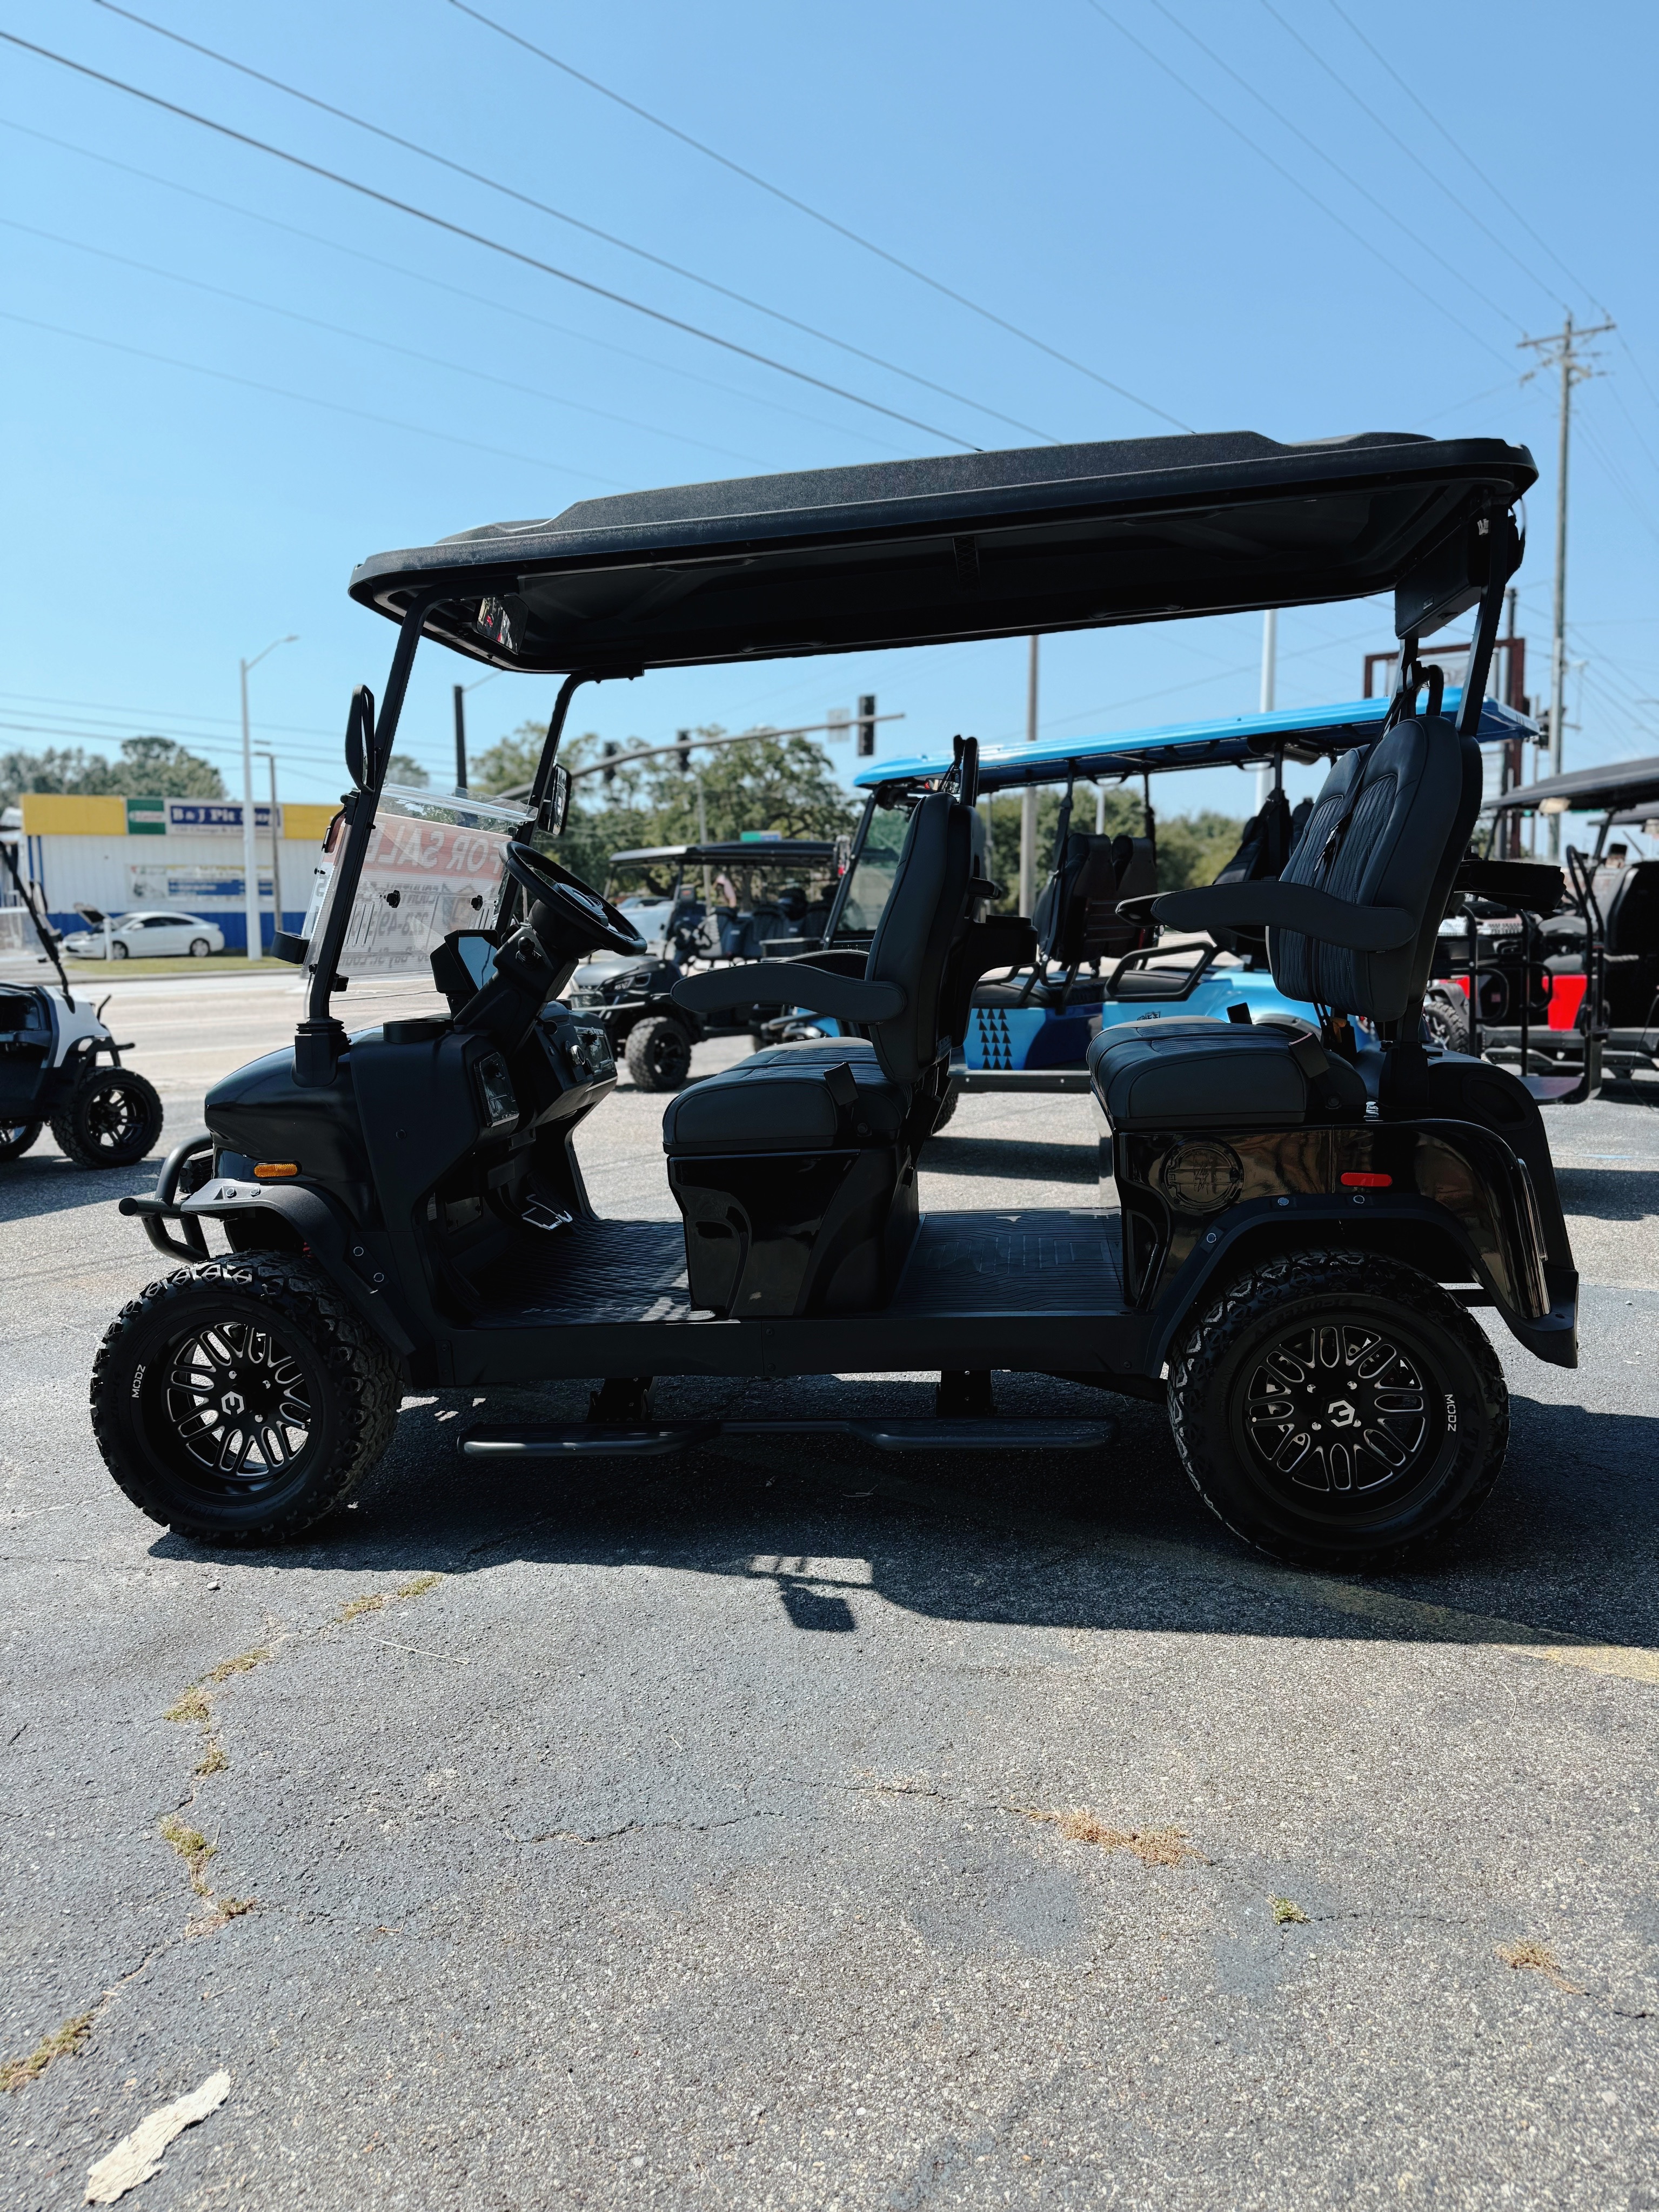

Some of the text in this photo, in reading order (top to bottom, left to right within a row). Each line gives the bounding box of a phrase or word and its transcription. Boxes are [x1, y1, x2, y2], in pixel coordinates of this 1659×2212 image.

[172, 808, 184, 821] B
[210, 809, 236, 822] Pit
[131, 1364, 146, 1398] MODZ
[1444, 1394, 1457, 1432] MODZ
